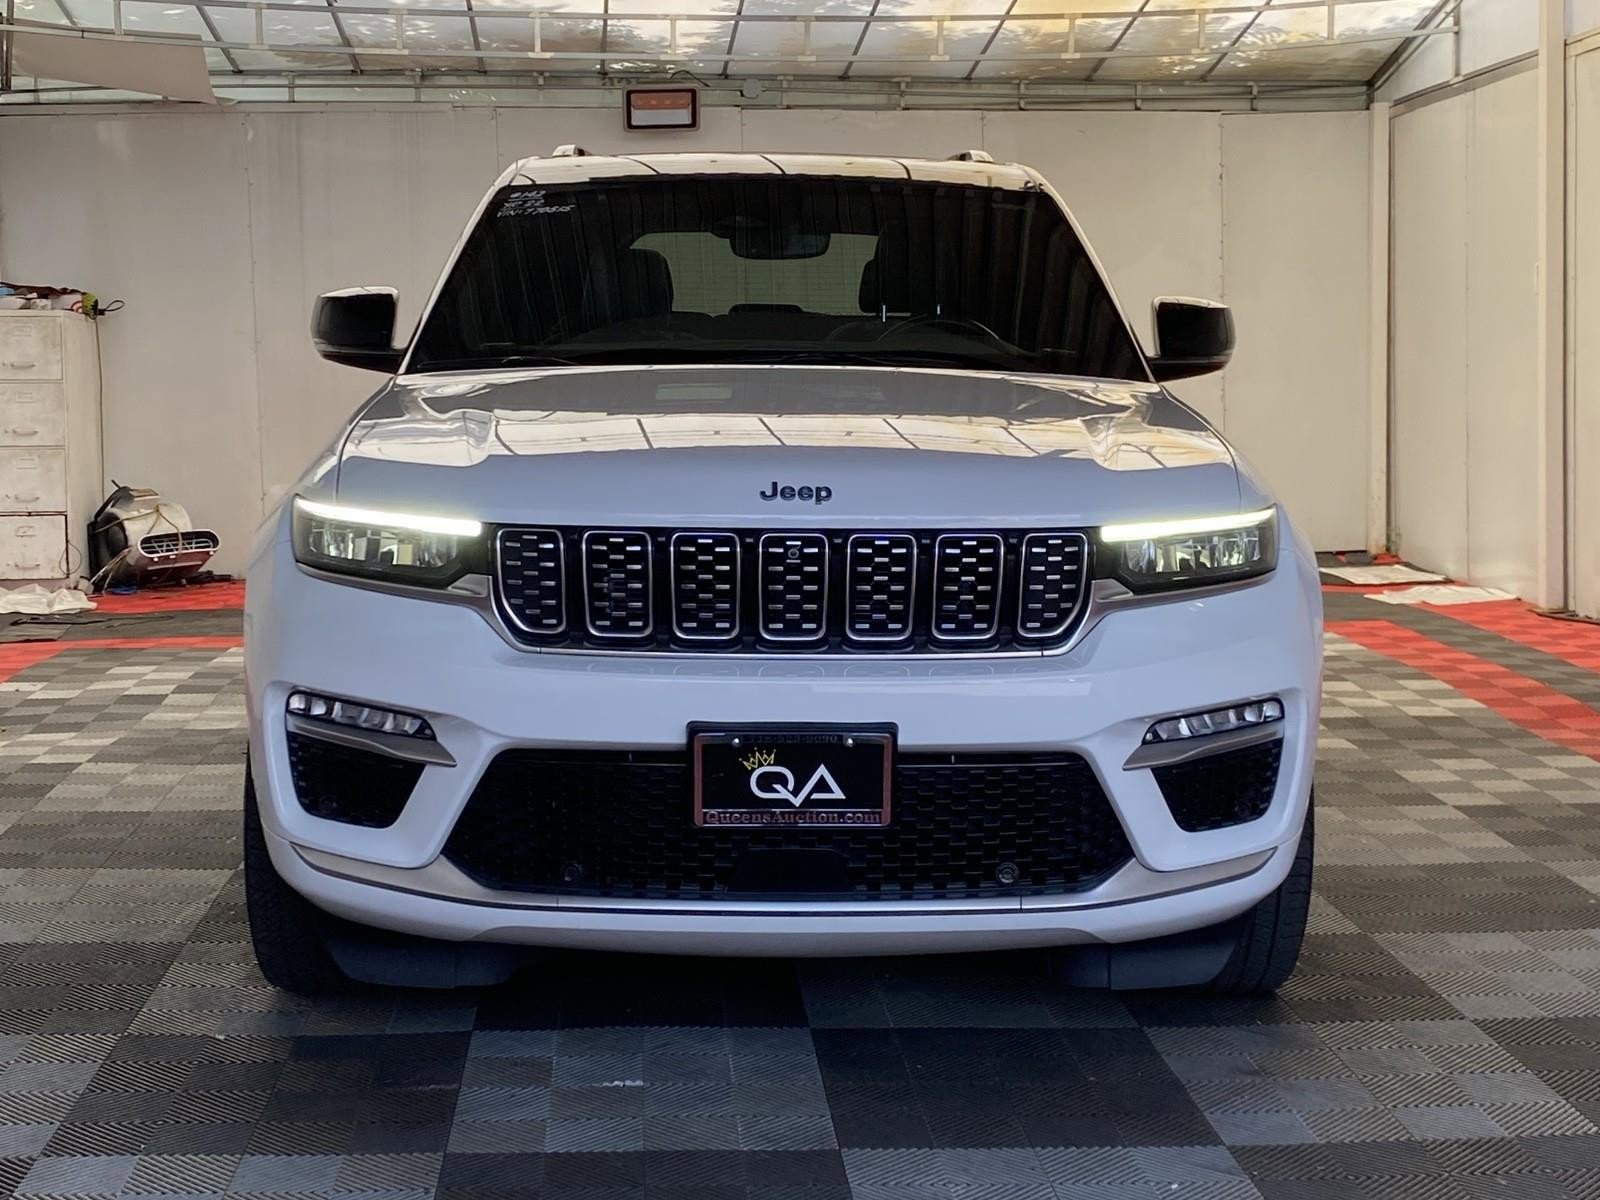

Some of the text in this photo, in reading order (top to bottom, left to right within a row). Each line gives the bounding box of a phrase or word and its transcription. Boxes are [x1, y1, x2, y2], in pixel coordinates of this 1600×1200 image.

[760, 481, 832, 505] Jeep
[750, 763, 846, 807] QA
[706, 811, 880, 824] QueensAuction.com
